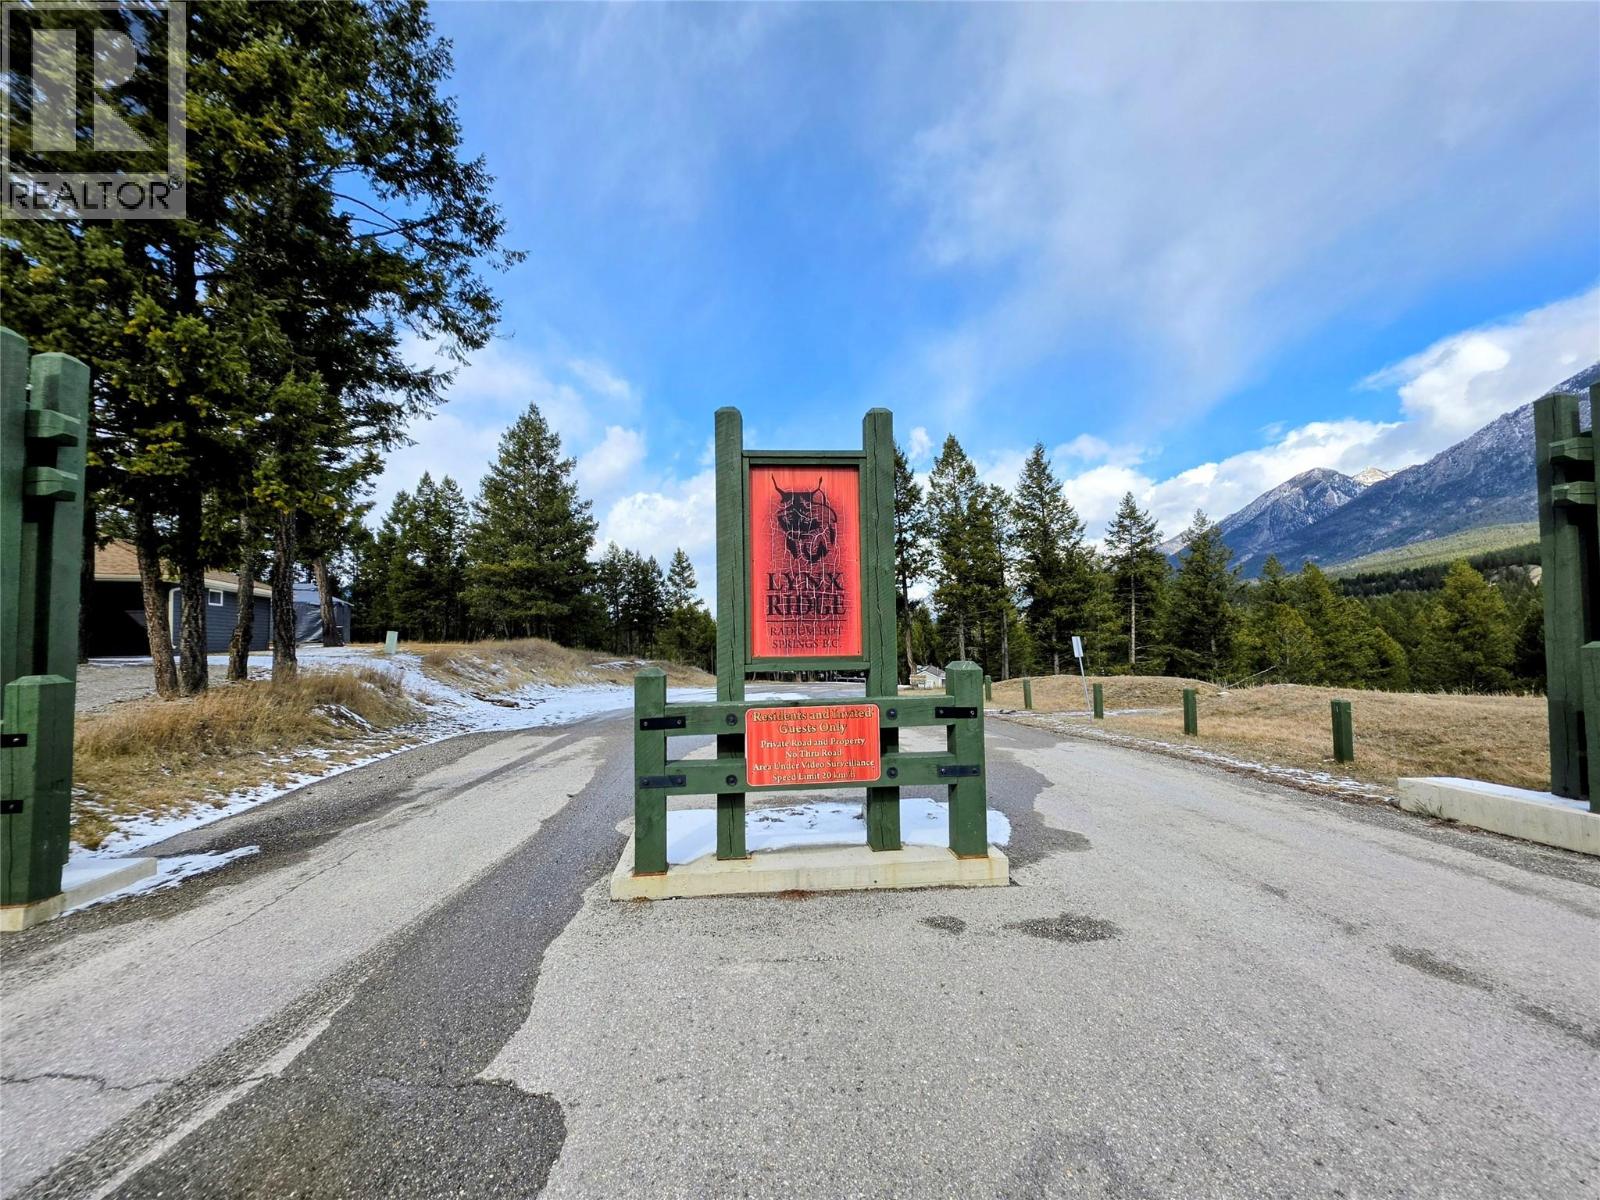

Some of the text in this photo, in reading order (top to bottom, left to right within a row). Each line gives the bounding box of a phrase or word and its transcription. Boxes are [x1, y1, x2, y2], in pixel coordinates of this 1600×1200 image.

[767, 572, 845, 591] LYNX
[767, 594, 847, 615] RIDGE
[770, 625, 842, 637] RADIUM HOT
[772, 638, 819, 649] SPRINGS
[752, 706, 874, 722] Residents and Invited
[779, 721, 847, 735] Guests Only
[760, 737, 866, 749] Private Road and Property
[800, 750, 820, 758] Thru
[821, 749, 842, 757] Road
[752, 759, 875, 771] Area Under Video Surveillance
[772, 773, 797, 784] Speed
[798, 772, 820, 780] Limit
[822, 771, 832, 779] 20
